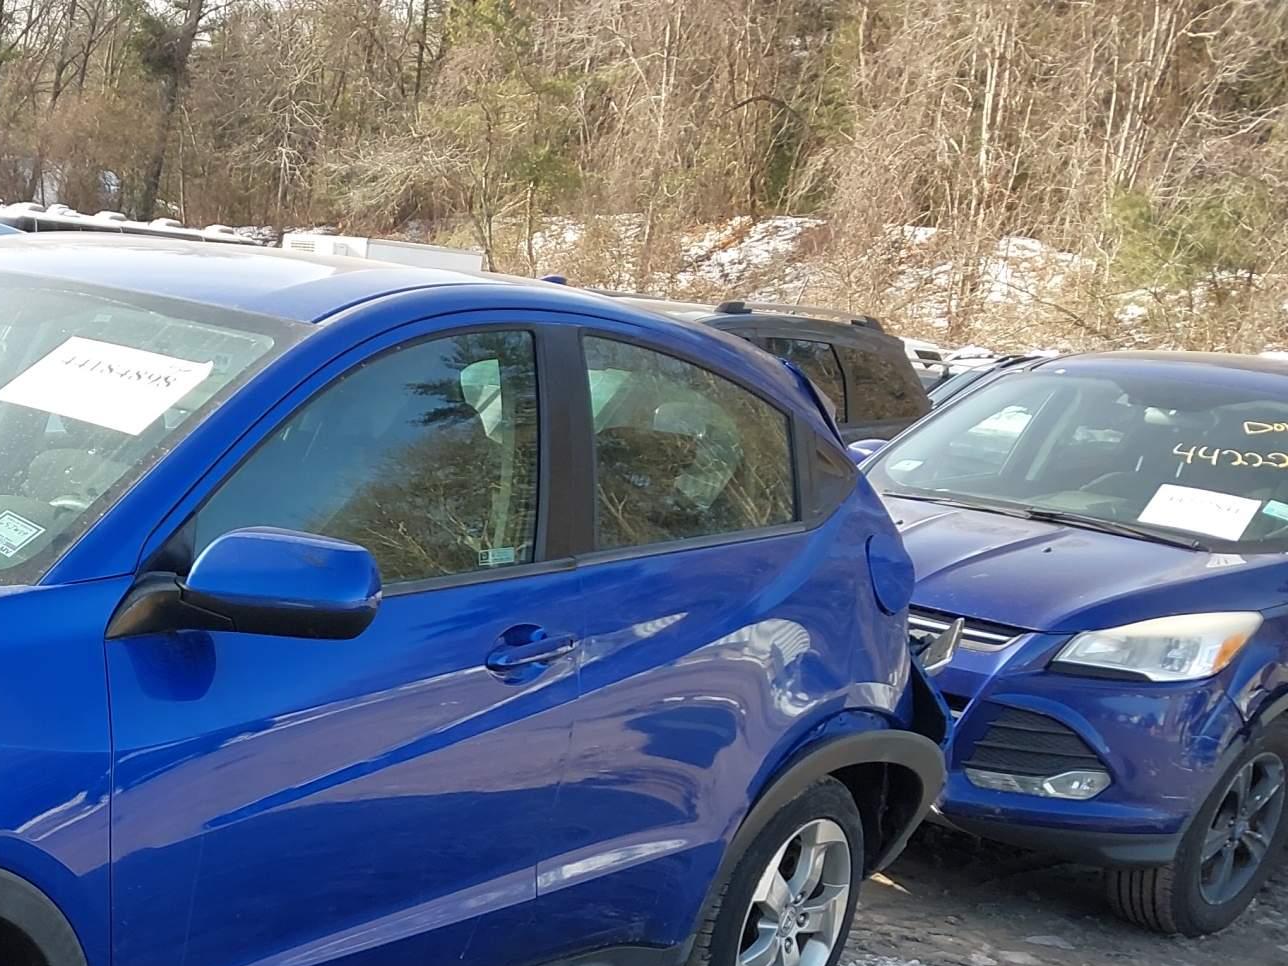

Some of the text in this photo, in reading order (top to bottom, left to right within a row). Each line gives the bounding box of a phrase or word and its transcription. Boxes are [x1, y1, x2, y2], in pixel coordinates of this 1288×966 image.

[61, 355, 177, 389] 44184898
[1243, 421, 1288, 435] Do
[1172, 442, 1288, 469] 44222
